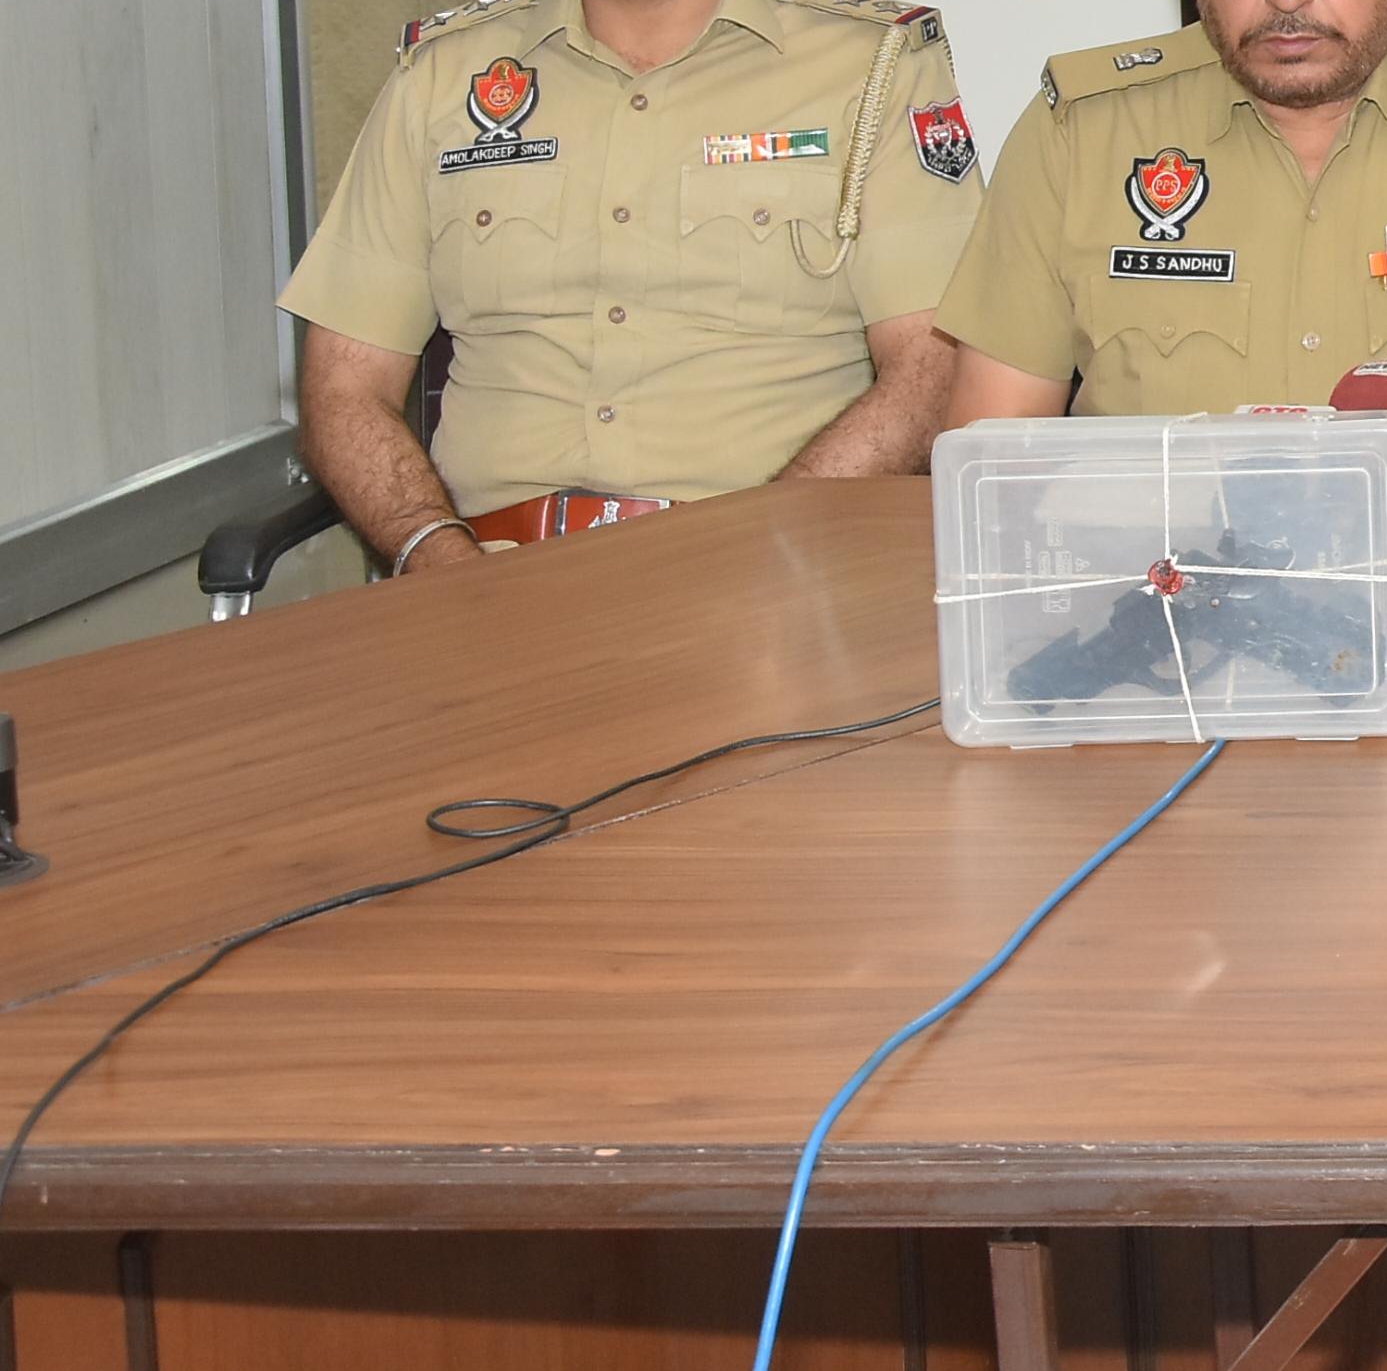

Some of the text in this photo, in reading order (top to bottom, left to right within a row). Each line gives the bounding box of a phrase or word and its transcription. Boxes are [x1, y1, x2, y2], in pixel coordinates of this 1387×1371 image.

[441, 142, 553, 165] AMOLAKDEEP SINGH
[1122, 254, 1223, 273] J S SANDHU
